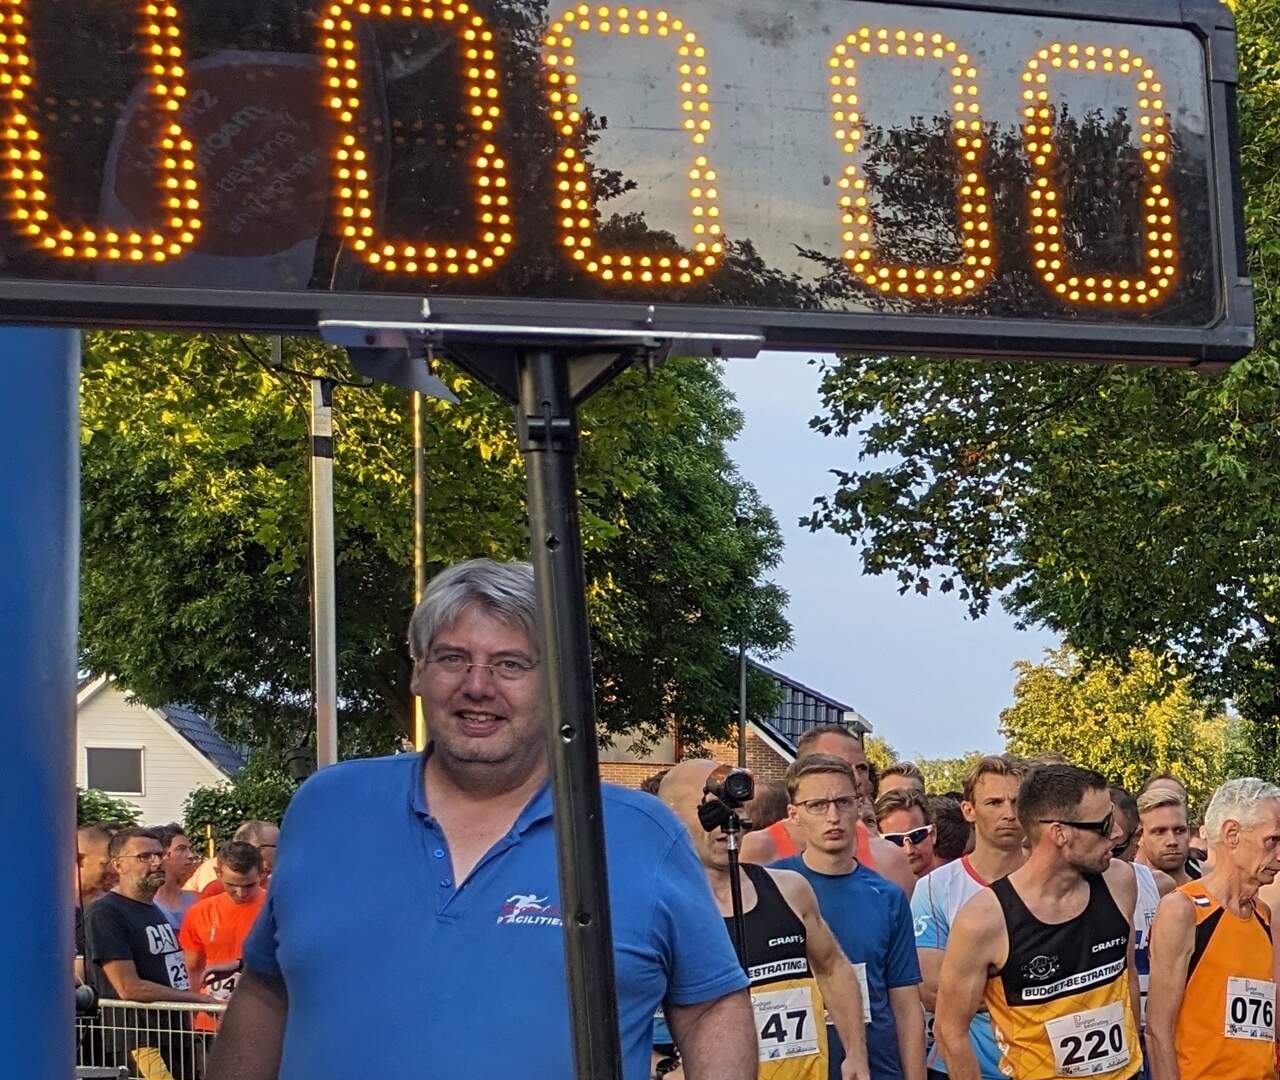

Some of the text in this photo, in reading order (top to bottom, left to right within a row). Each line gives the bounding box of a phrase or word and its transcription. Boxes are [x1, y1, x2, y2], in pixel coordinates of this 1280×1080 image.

[768, 934, 800, 947] CRAFT
[1092, 937, 1121, 953] CRAFT
[760, 1010, 808, 1043] 47
[1231, 996, 1273, 1027] 076
[1060, 1023, 1124, 1067] 220
